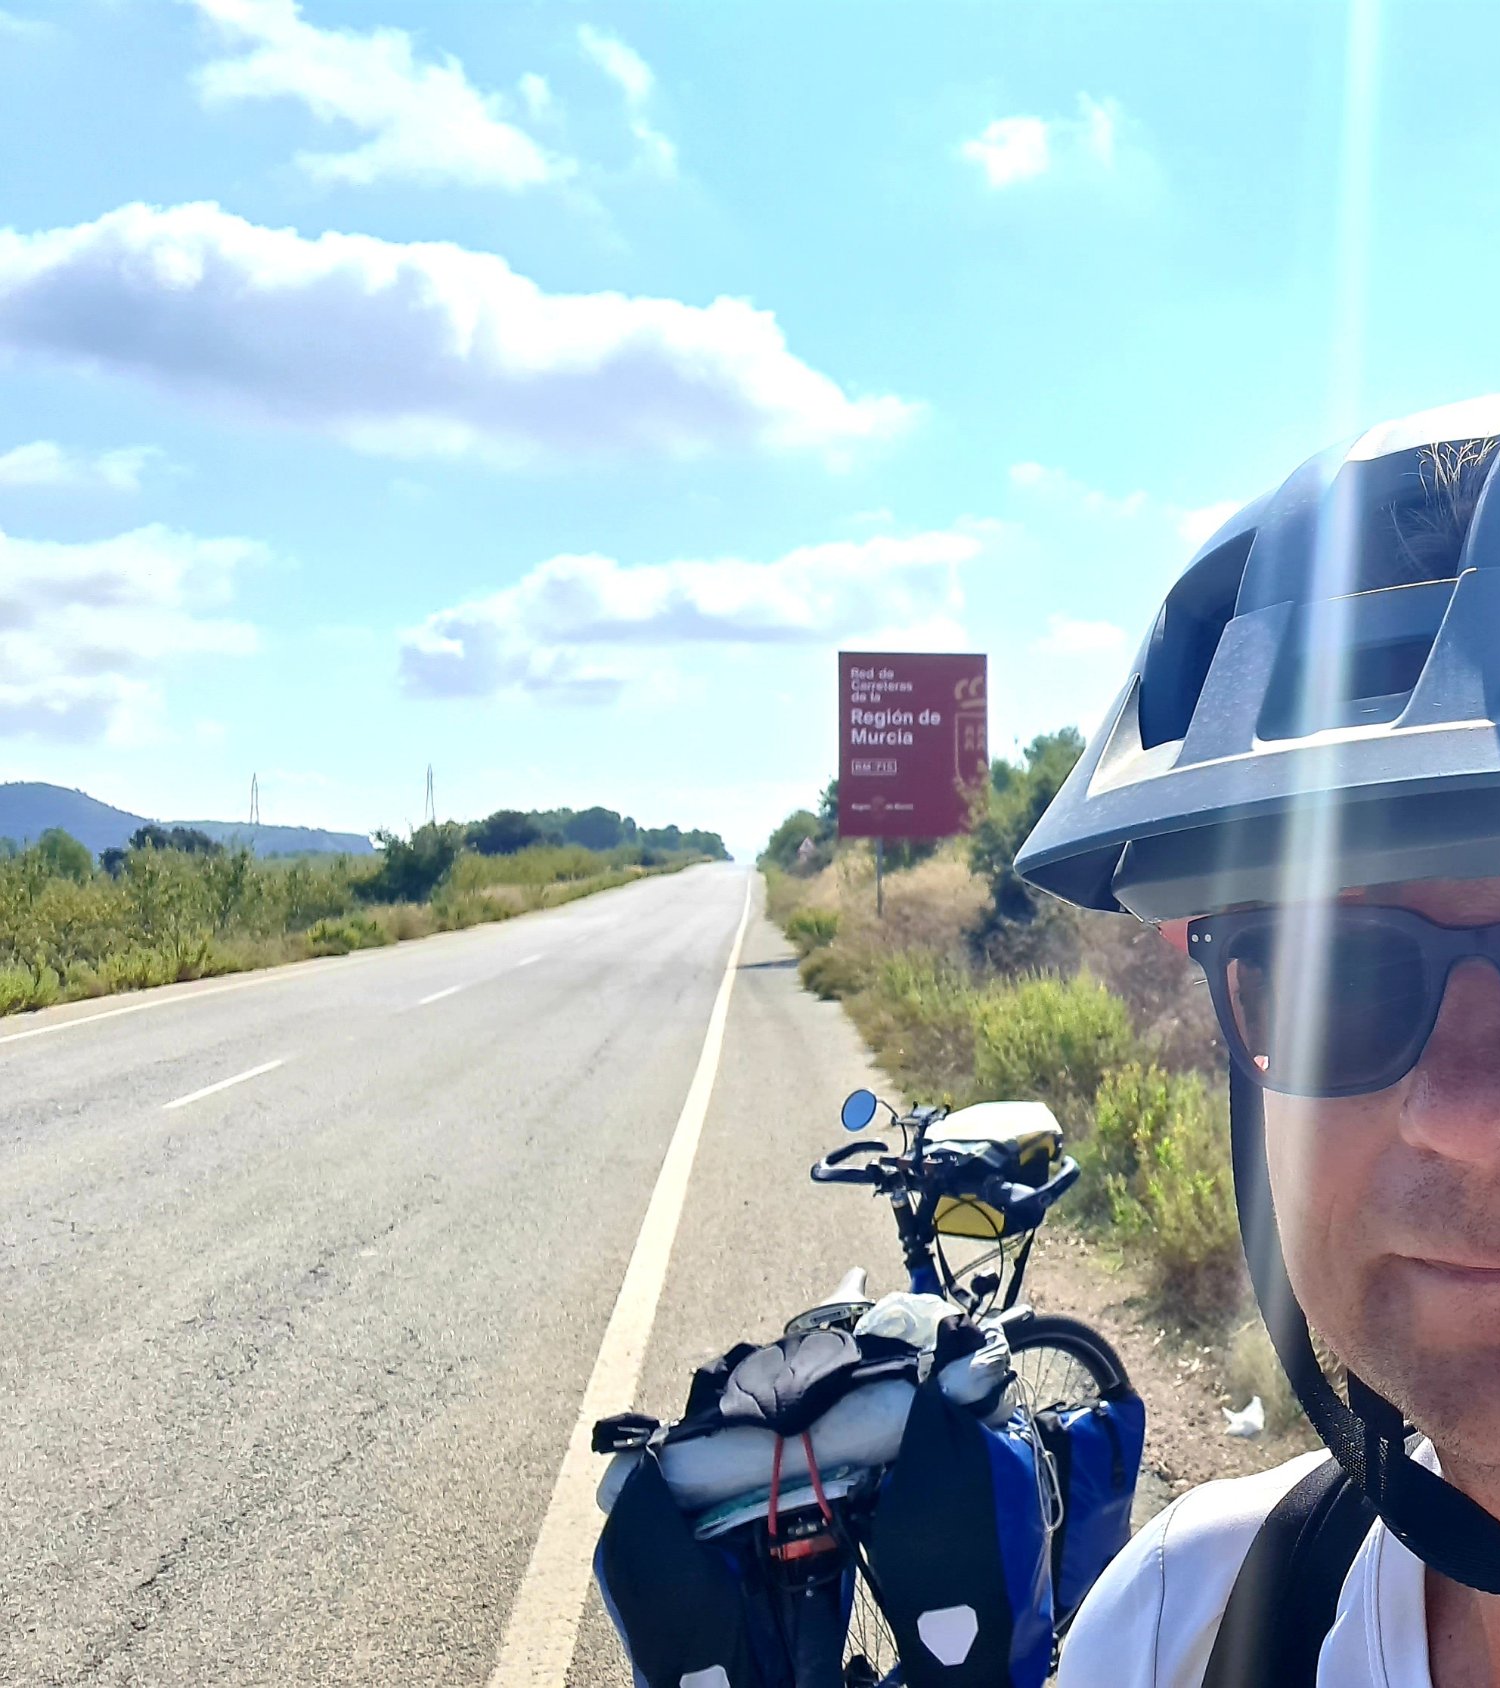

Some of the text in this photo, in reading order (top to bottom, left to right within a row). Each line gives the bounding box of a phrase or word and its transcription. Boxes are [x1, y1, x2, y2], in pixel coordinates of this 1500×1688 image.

[851, 667, 895, 680] Red de
[851, 680, 913, 692] Carreteras
[851, 691, 881, 703] de la
[851, 707, 941, 730] Región de
[851, 727, 914, 746] Murcia
